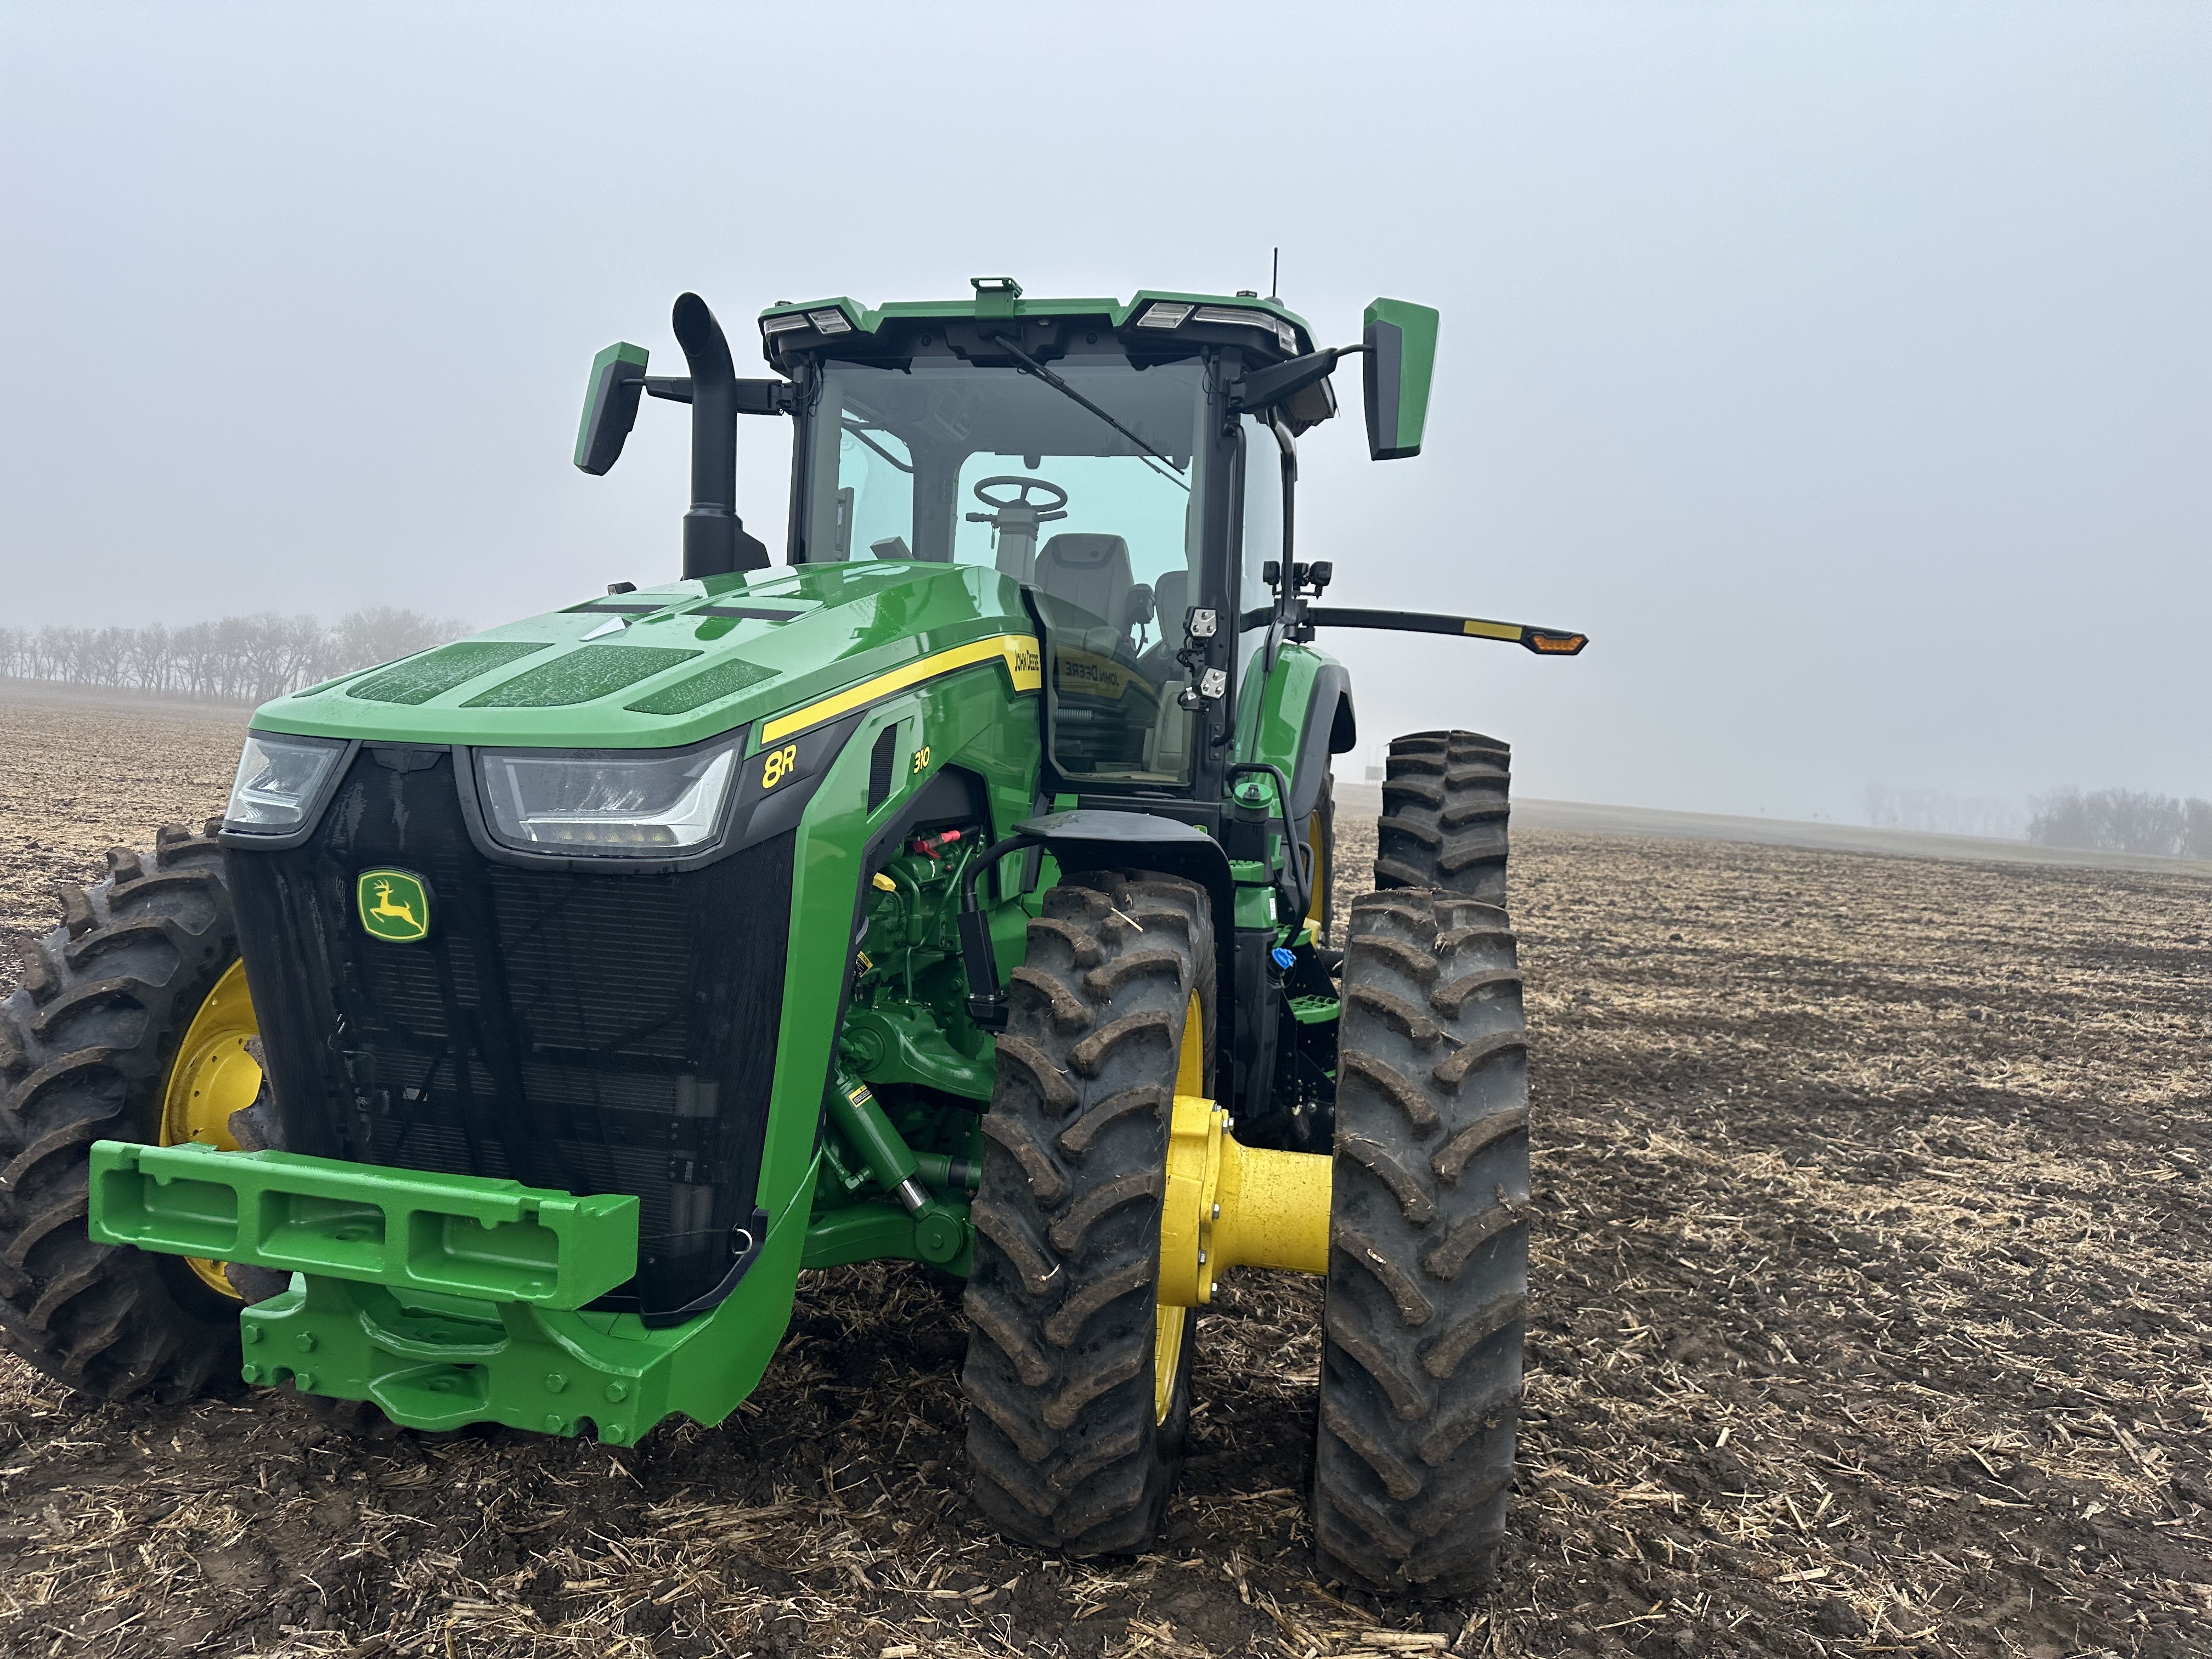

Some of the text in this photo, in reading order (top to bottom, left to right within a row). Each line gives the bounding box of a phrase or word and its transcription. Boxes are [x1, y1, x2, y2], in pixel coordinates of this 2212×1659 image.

[1015, 649, 1039, 672] JOHN DEERE
[762, 744, 797, 788] 8R
[913, 746, 930, 774] 310
